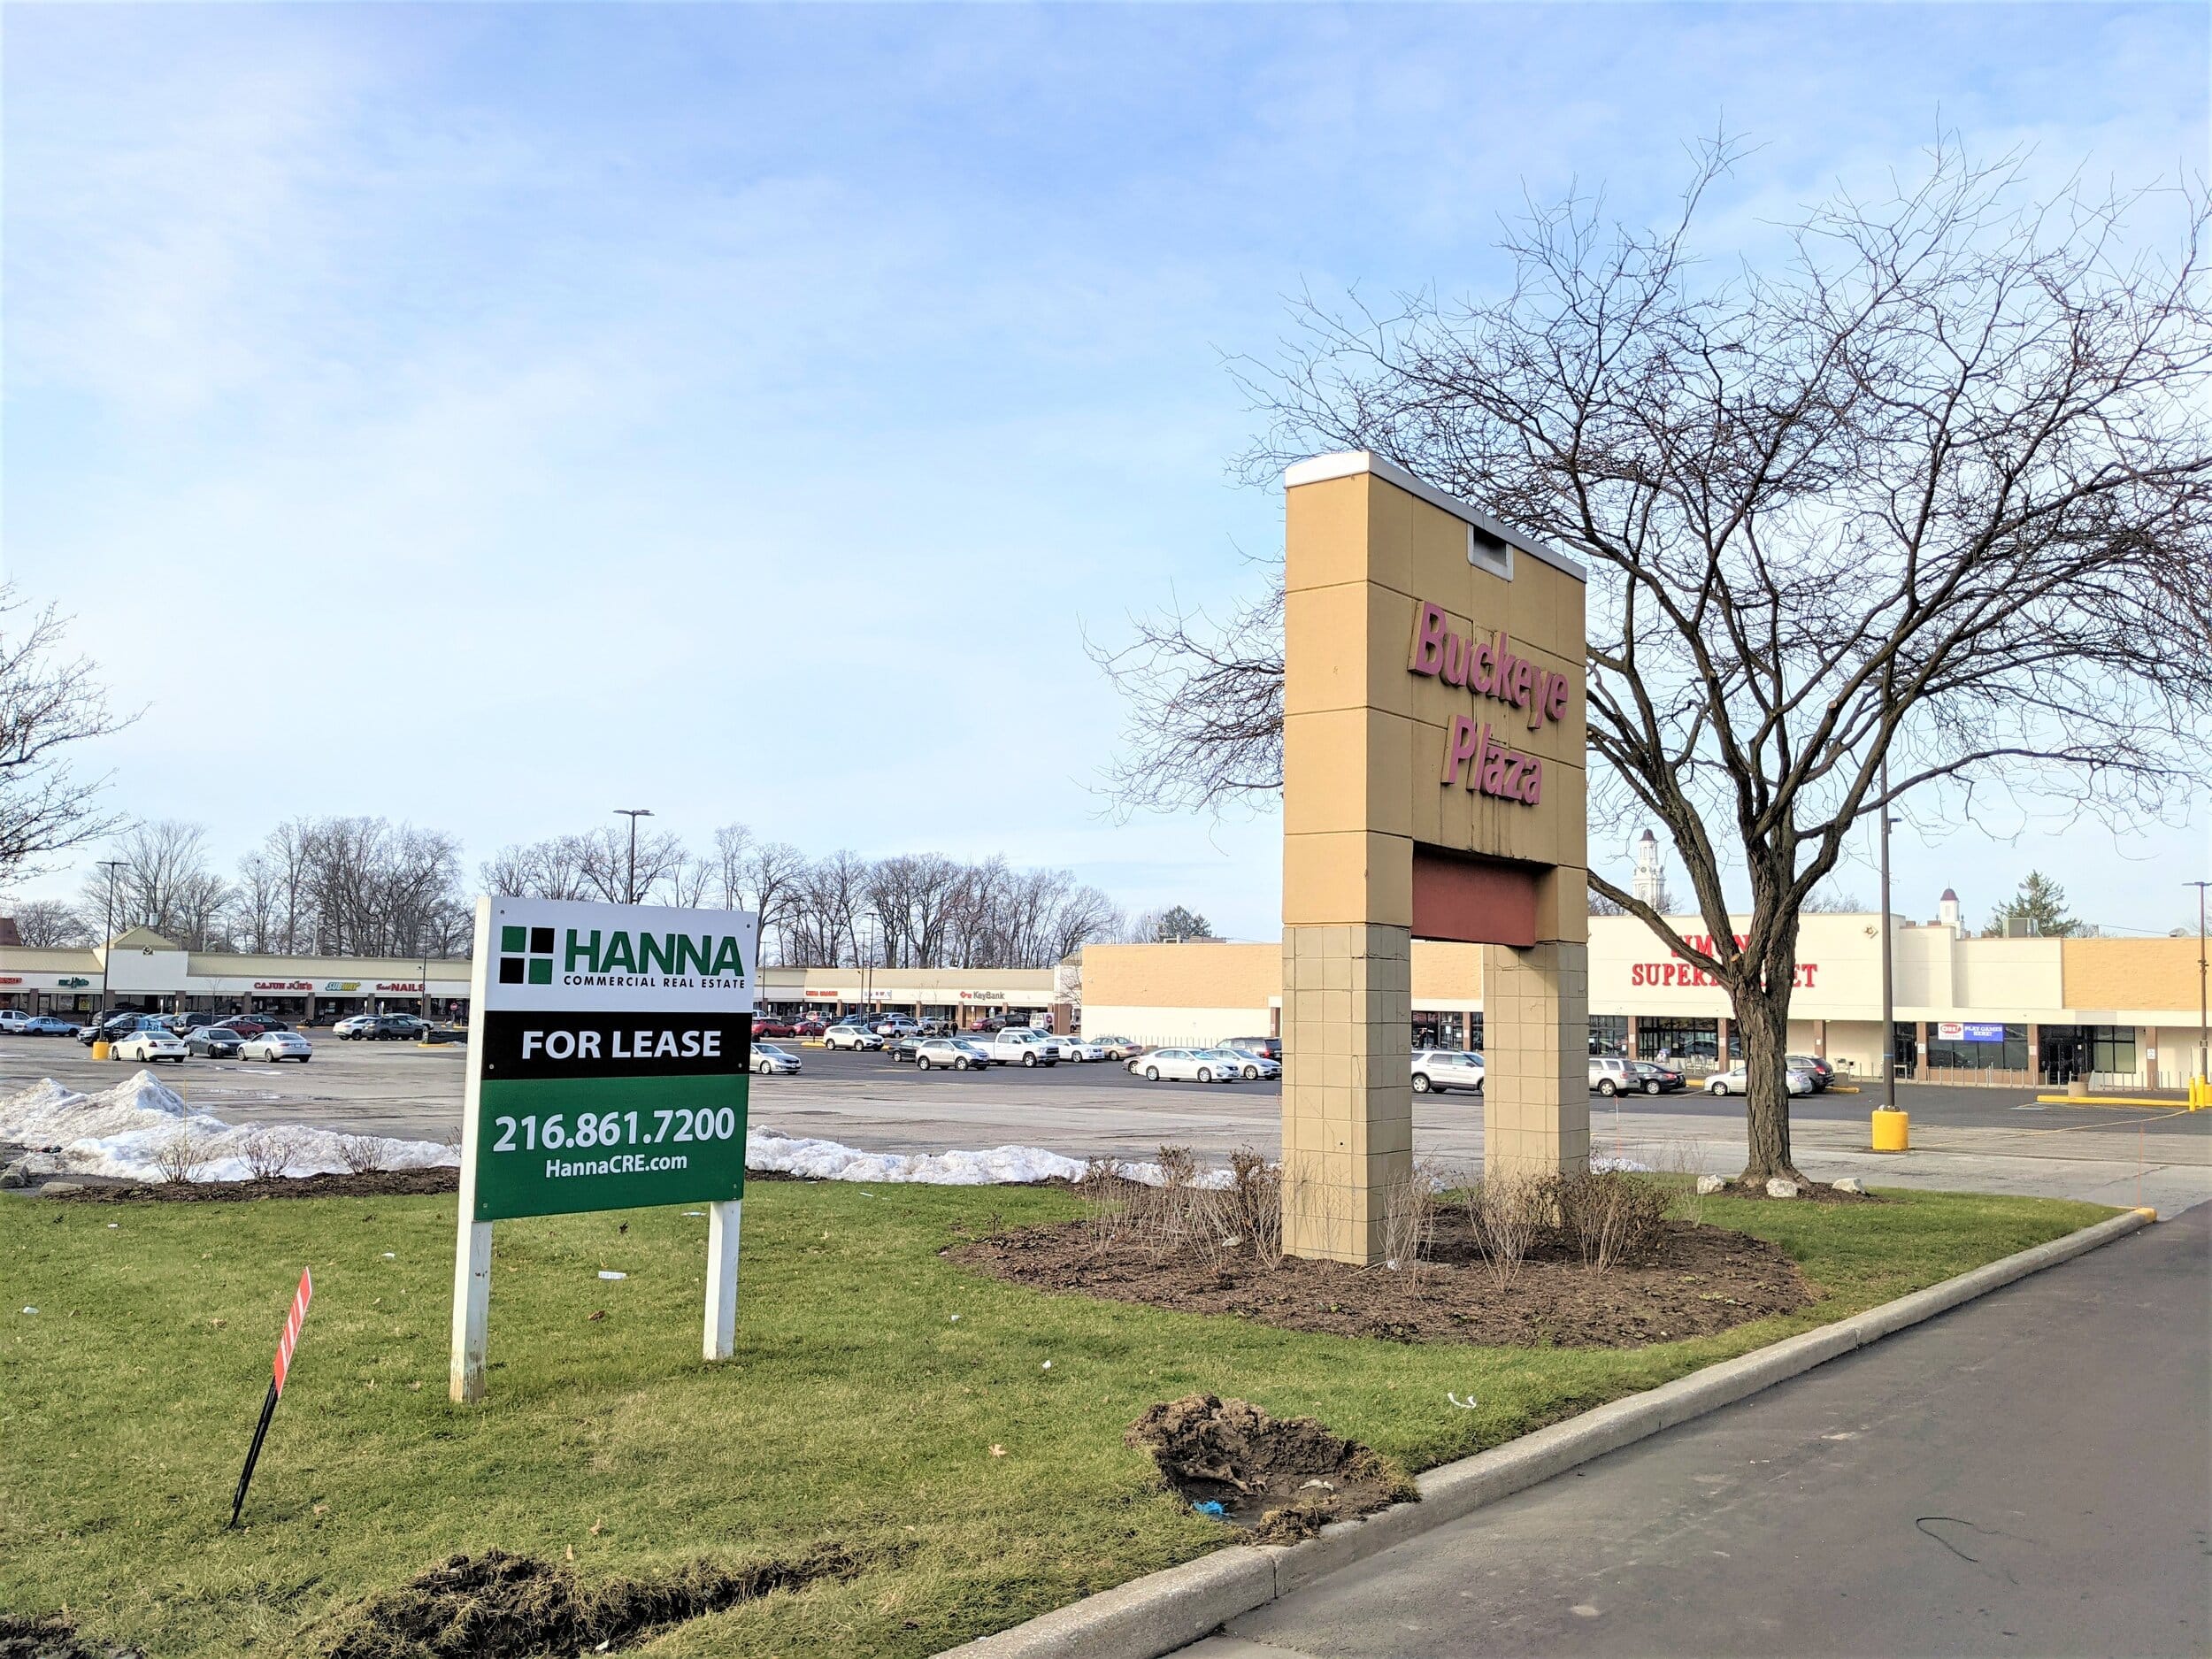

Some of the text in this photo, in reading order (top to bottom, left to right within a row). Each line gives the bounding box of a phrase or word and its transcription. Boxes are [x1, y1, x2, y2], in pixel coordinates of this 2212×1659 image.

[1408, 600, 1570, 729] Buckeye
[1440, 714, 1542, 805] Plaza
[565, 928, 745, 977] HANNA
[326, 981, 362, 991] SUBWAY
[390, 983, 426, 992] NAILS
[564, 975, 745, 989] COMMERCIAL REAL ESTATE
[973, 991, 1005, 1001] KeyBank
[522, 1030, 721, 1060] FOR LEASE
[493, 1107, 735, 1152] 216.861.7200
[545, 1154, 687, 1179] HannaCRE.com
